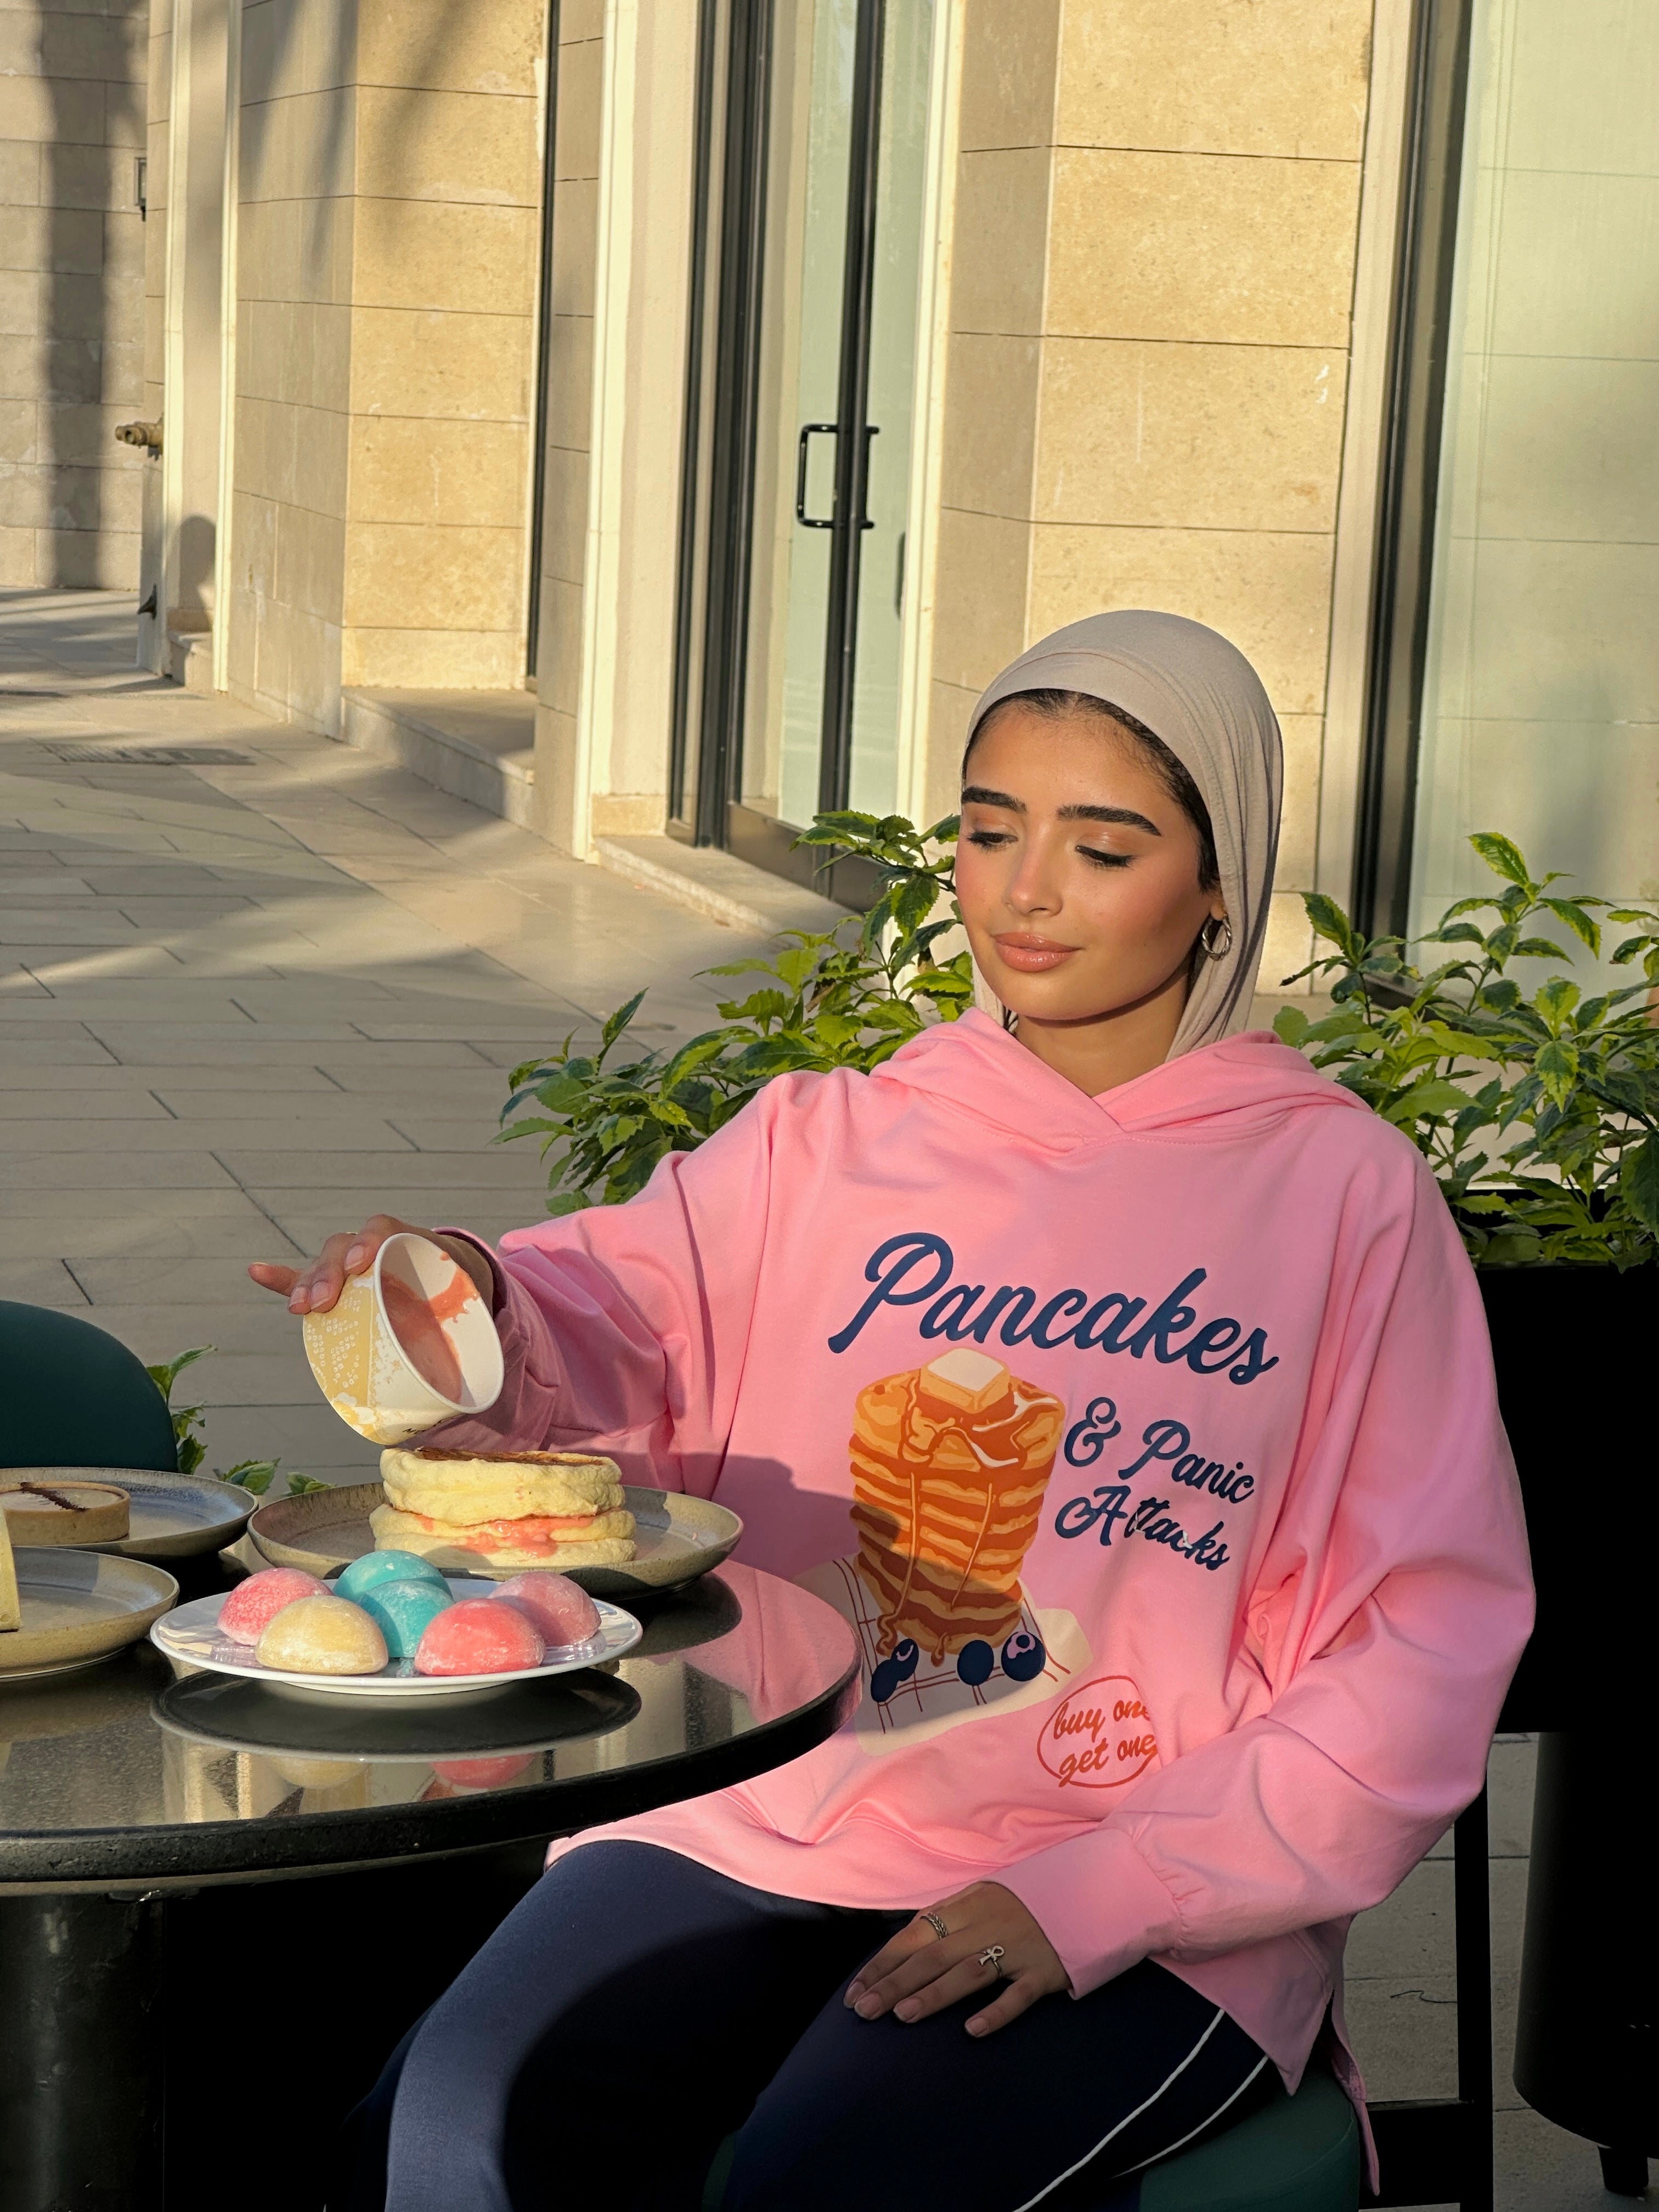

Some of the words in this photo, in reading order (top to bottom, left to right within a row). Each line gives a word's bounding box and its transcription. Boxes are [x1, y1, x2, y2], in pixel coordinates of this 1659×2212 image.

[828, 1232, 1280, 1385] Pancakes
[1064, 1397, 1121, 1468] &
[1118, 1419, 1255, 1504] Panic
[1054, 1485, 1231, 1571] Attacks
[1053, 1701, 1106, 1743] buy
[1058, 1737, 1110, 1788] get
[1117, 1734, 1158, 1762] one
